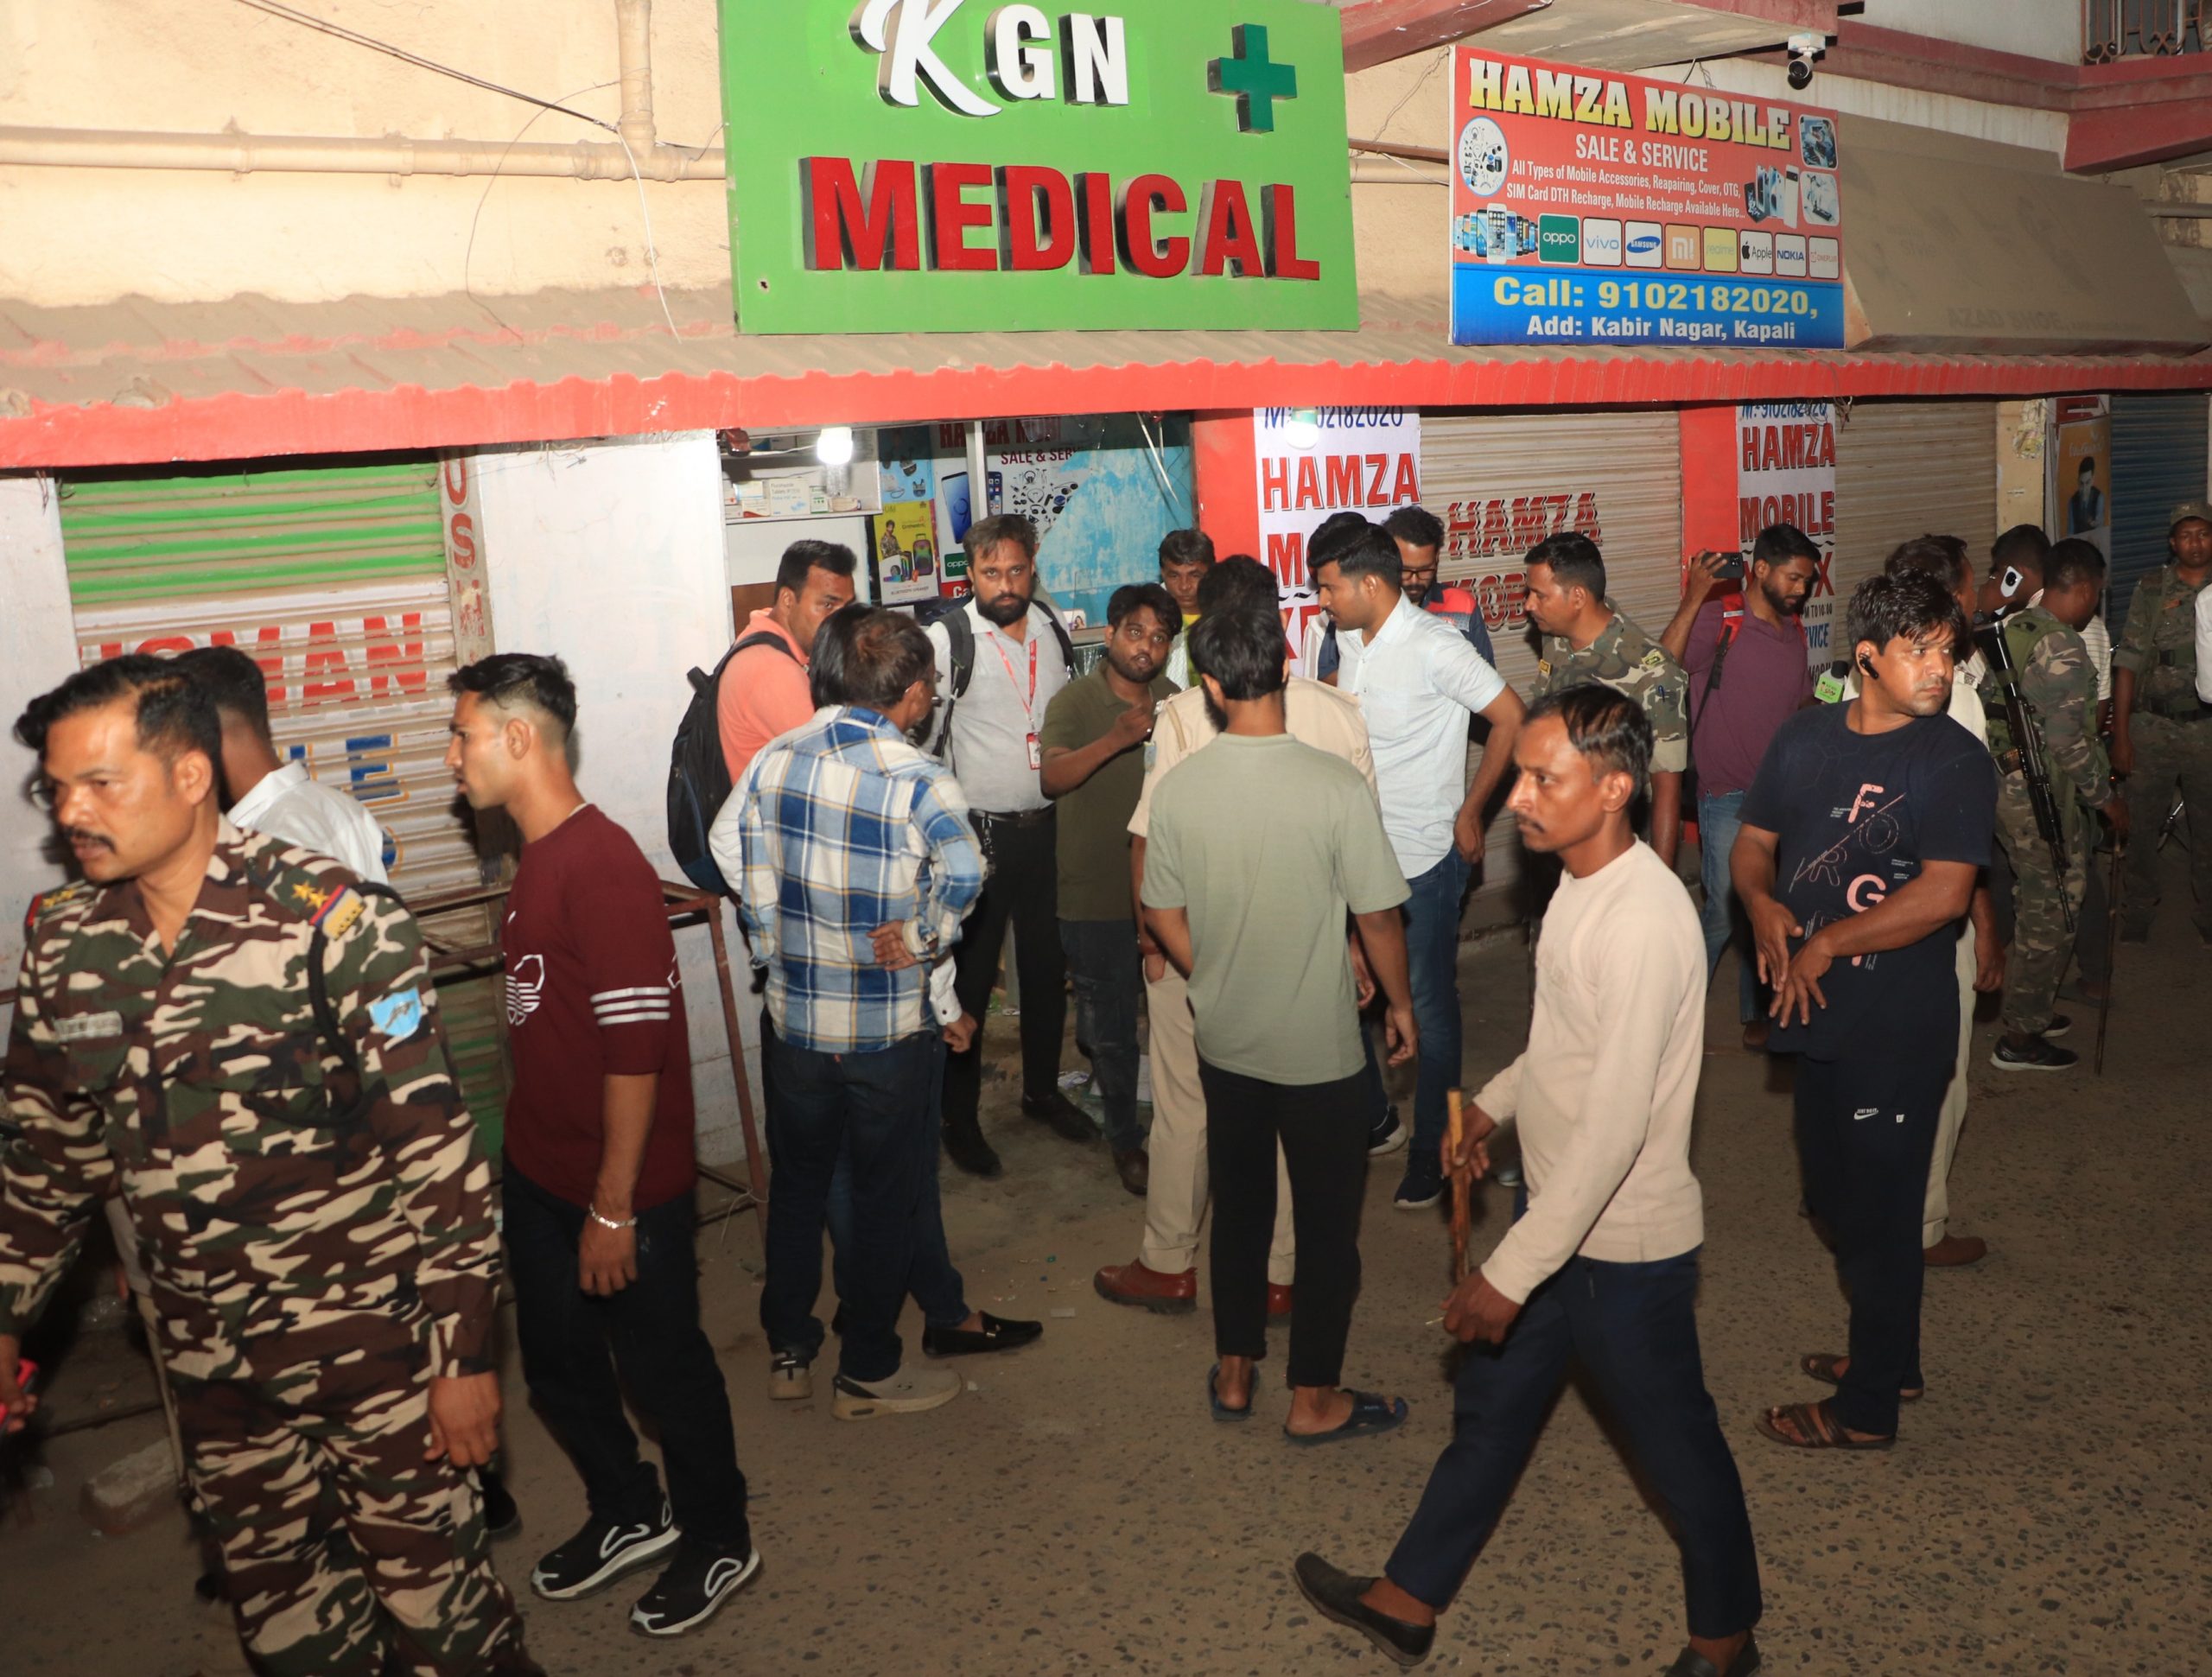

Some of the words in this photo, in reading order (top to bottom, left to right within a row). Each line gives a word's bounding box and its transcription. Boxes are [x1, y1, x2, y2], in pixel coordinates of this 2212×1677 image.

[849, 0, 1128, 117] KGN
[1469, 58, 1633, 130] HAMZA
[1644, 86, 1792, 151] MOBILE
[1576, 134, 1620, 162] SALE
[1624, 141, 1637, 165] &
[1642, 143, 1708, 172] SERVICE
[1512, 159, 1525, 175] All
[1528, 161, 1554, 181] Types
[1555, 165, 1565, 180] of
[1567, 165, 1597, 183] Mobile
[1599, 168, 1651, 189] Accessories,
[1653, 175, 1697, 196] Reapairing,
[1699, 179, 1722, 197] Cover,
[1723, 182, 1741, 199] OTG,
[798, 156, 1320, 280] MEDICAL
[1506, 182, 1525, 200] SIM
[1528, 184, 1548, 202] Card
[1550, 187, 1569, 203] DTH
[1571, 189, 1614, 210] Recharge,
[1616, 193, 1644, 210] Mobile
[1646, 195, 1683, 216] Recharge
[1685, 200, 1721, 217] Available
[1722, 203, 1745, 219] Here...
[1542, 232, 1576, 245] oppo
[1586, 235, 1619, 250] vivo
[1630, 240, 1657, 249] SAMSUNG
[1751, 246, 1772, 260] Apple
[1777, 250, 1804, 261] NOKIA
[1494, 276, 1583, 308] Call:
[1598, 281, 1818, 319] 9102182020,
[1527, 314, 1582, 336] Add:
[1591, 316, 1651, 338] Kabir
[1659, 317, 1726, 341] Nagar,
[1734, 319, 1796, 342] Kapali
[1001, 450, 1033, 465] SALE
[1036, 450, 1046, 462] &
[1742, 422, 1835, 471] HAMZA
[1262, 453, 1422, 511] HAMZA
[1448, 492, 1603, 560] HAMZA
[1740, 492, 1835, 543] MOBILE
